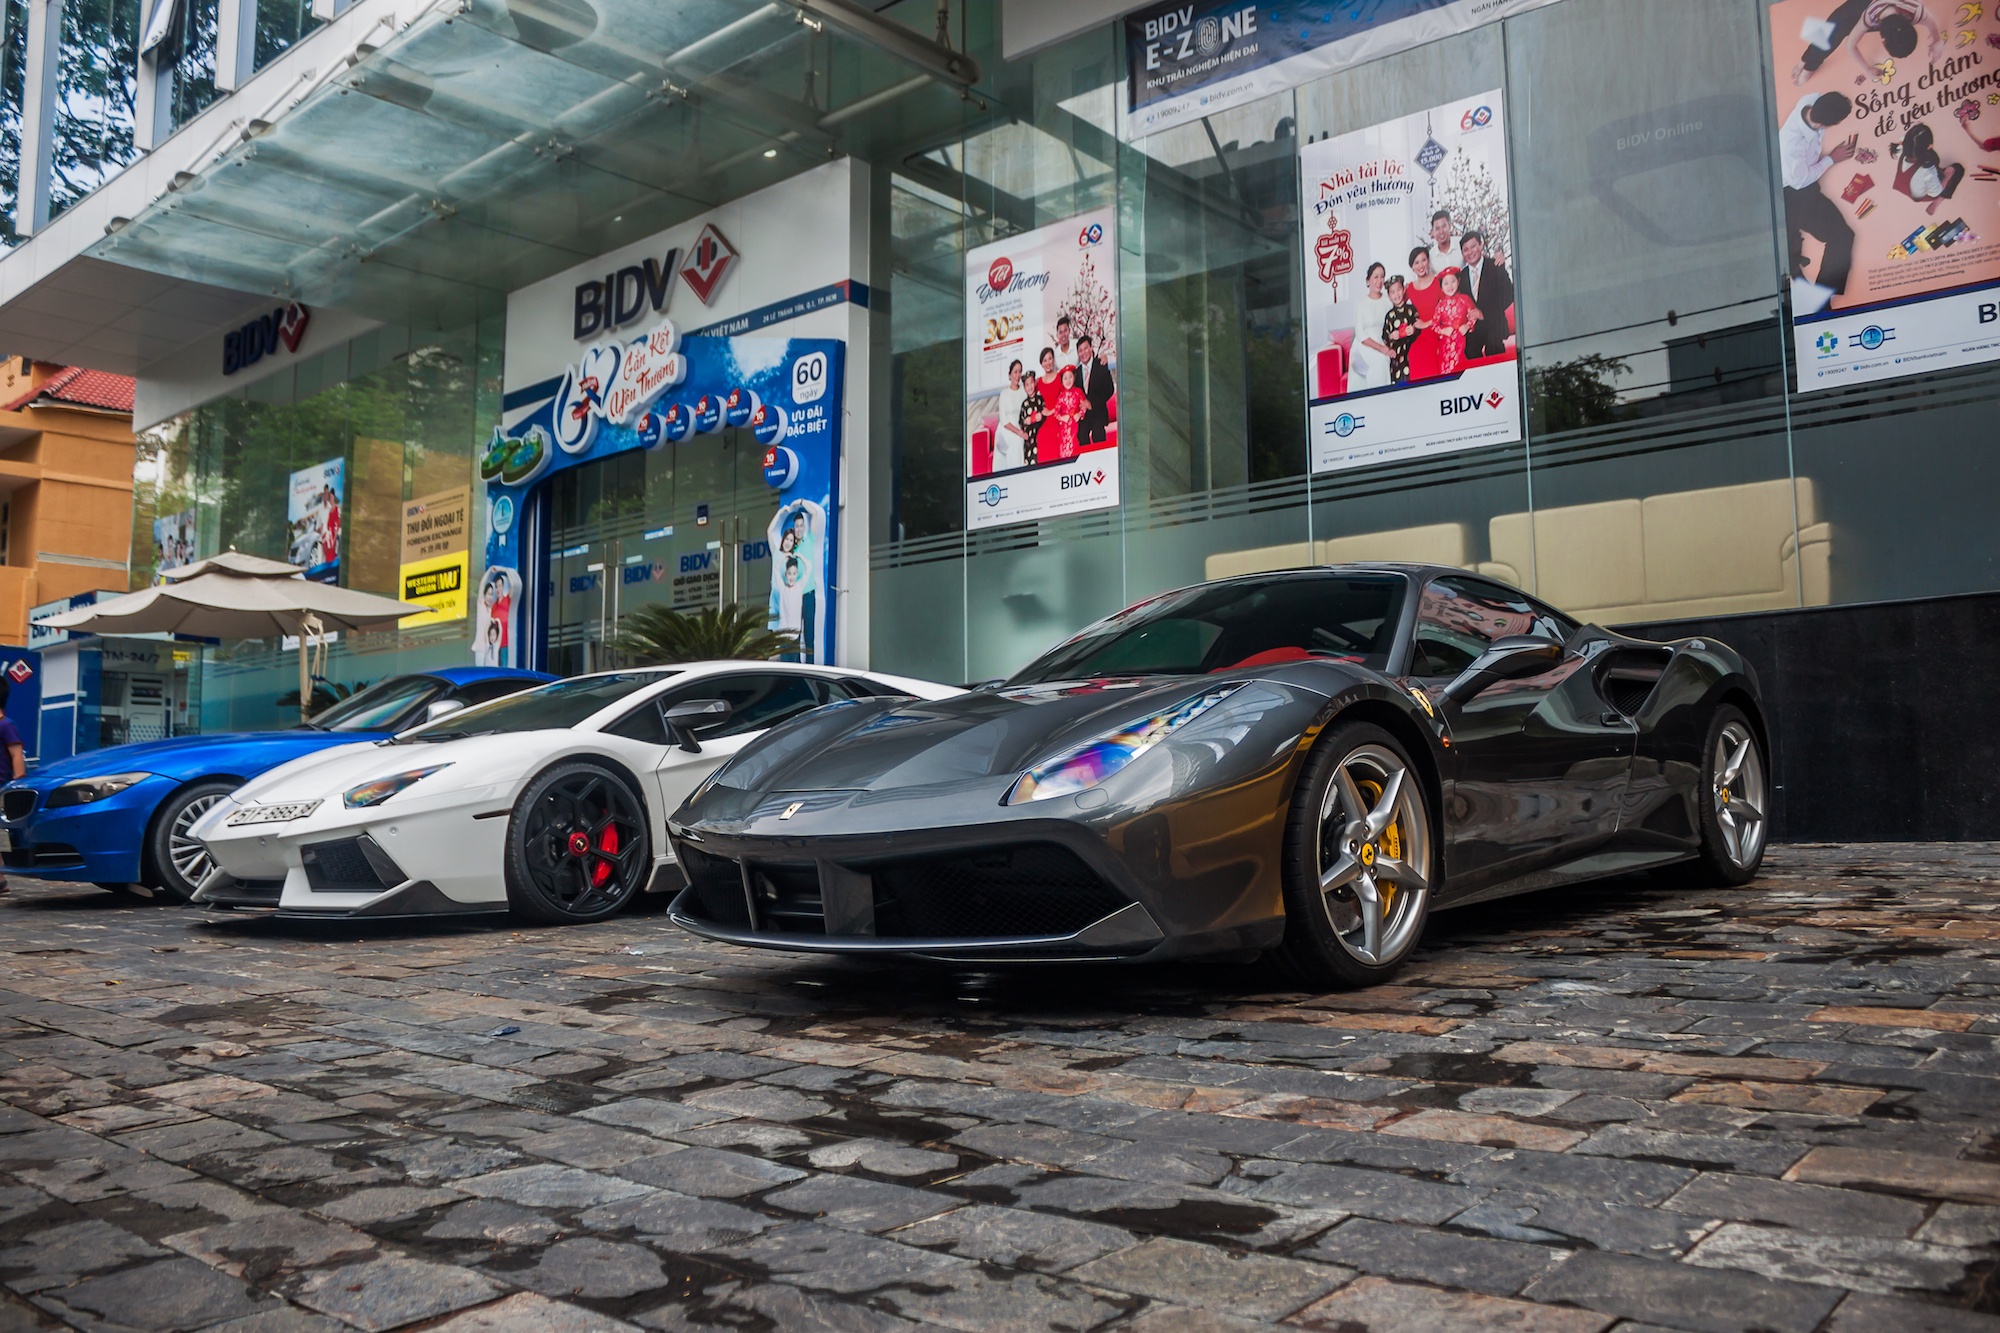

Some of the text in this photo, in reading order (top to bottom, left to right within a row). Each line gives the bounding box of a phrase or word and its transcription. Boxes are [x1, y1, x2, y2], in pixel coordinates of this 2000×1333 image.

[1471, 3, 1491, 15] NGÂN
[1145, 5, 1193, 40] BIDV
[1146, 76, 1165, 89] KHU
[1186, 58, 1220, 77] NGHIỆM
[1221, 49, 1241, 63] HIỆN
[1243, 43, 1259, 56] ĐẠI
[1854, 51, 1983, 120] Sống chậm
[1156, 82, 1254, 120] 19009247 bidv.com.vn
[1874, 110, 1898, 138] để
[1900, 101, 1935, 131] yêu
[1616, 121, 1703, 151] BIDV Online
[1319, 159, 1404, 200] Nhà tài lộc
[1313, 178, 1415, 216] Đón yêu thương
[573, 247, 682, 341] BIDV
[729, 318, 749, 334] NAM
[222, 306, 284, 376] BIDV
[796, 358, 822, 385] 60
[800, 388, 819, 400] ngày
[1440, 392, 1484, 417] BIDV
[791, 405, 823, 422] ƯU ĐÃI
[787, 422, 806, 438] ĐẶC
[807, 418, 827, 434] BIỆT
[1061, 471, 1092, 490] BIDV
[406, 507, 464, 535] THU ĐỔI NGOẠI TỆ
[406, 527, 462, 547] FOREIGN EXCHANGE
[624, 563, 652, 585] BIDV
[680, 552, 711, 573] BIDV
[406, 569, 458, 590] WESTERN WU
[415, 583, 437, 596] UNION
[570, 574, 597, 593] BIDV
[686, 574, 702, 584] GIAO
